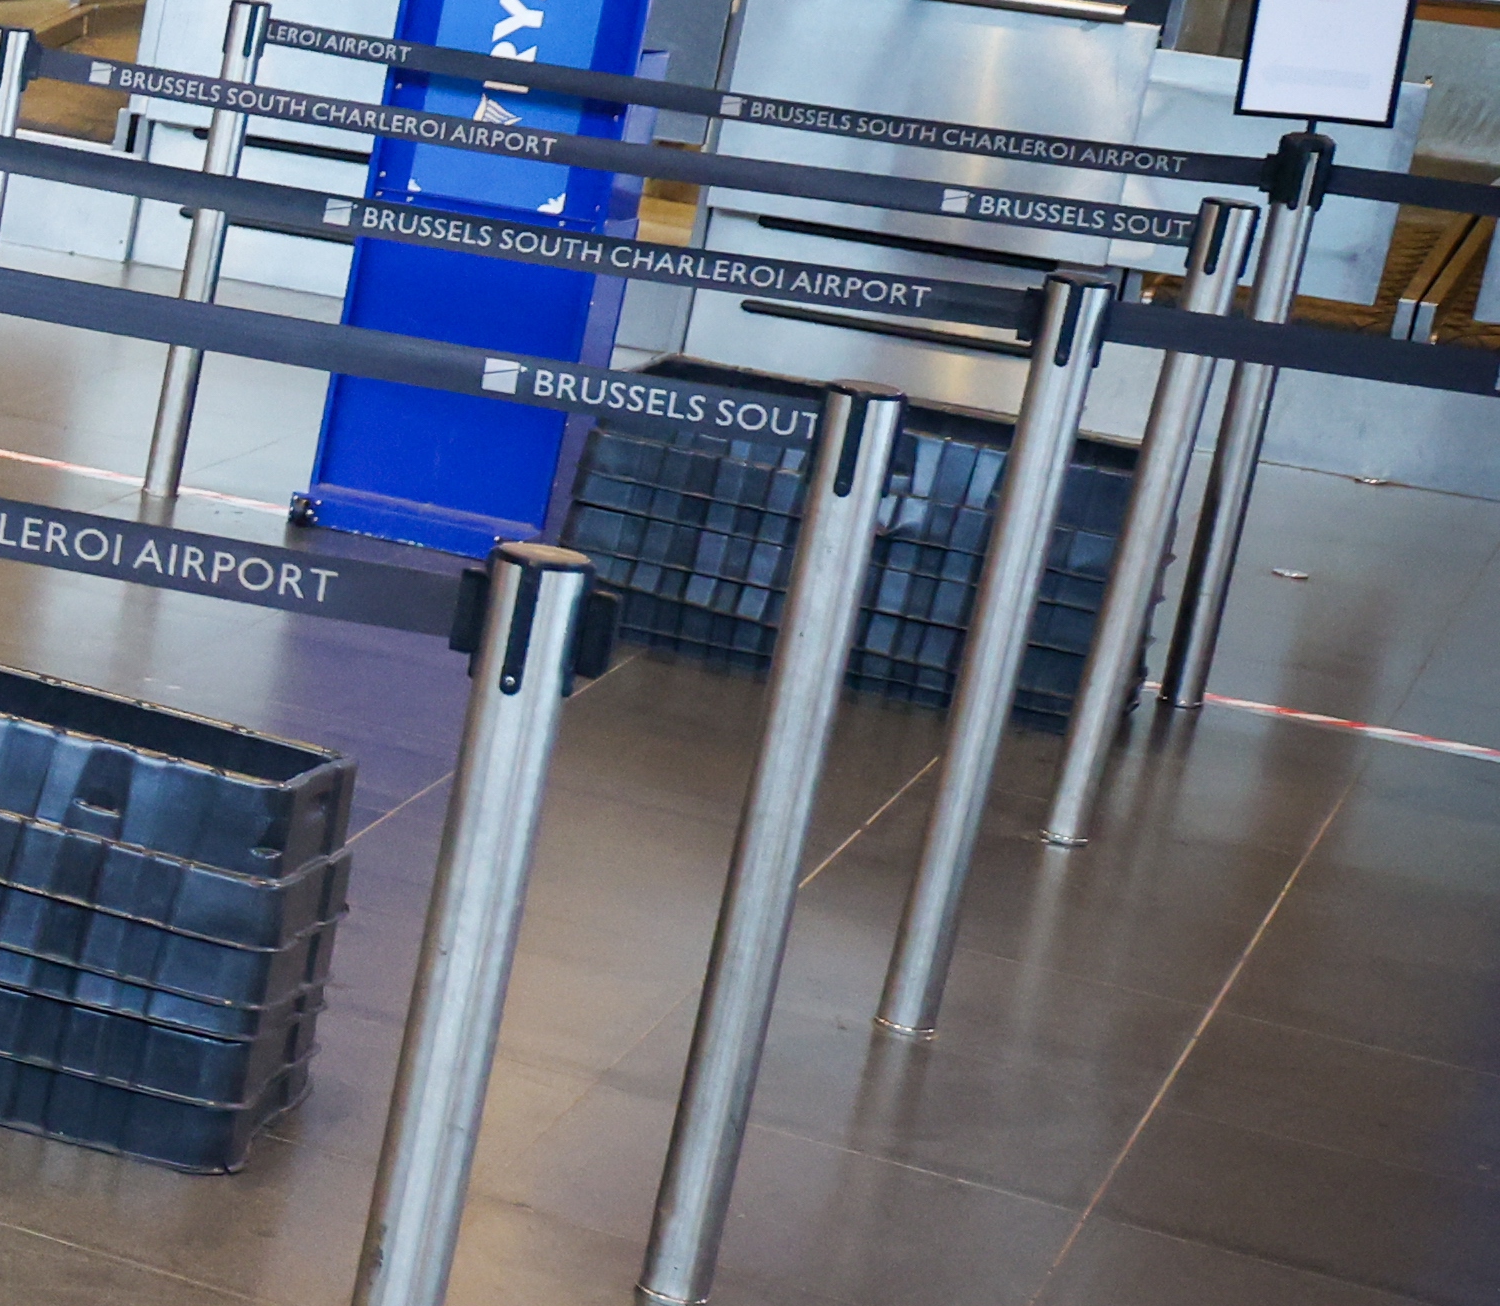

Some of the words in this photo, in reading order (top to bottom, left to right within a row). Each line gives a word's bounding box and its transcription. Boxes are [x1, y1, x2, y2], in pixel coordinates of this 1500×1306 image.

[120, 69, 220, 103] BRUSSELS
[225, 87, 306, 117] SOUTH
[312, 103, 446, 140] CHARLEROI
[451, 124, 557, 157] AIRPORT
[751, 101, 852, 133] BRUSSELS
[857, 118, 936, 143] SOUTH
[942, 127, 1075, 162] CHARLEROI
[1081, 147, 1187, 175] AIRPORT
[979, 195, 1105, 231] BRUSSELS
[1111, 211, 1192, 239] SOUT
[362, 205, 493, 248] BRUSSELS
[499, 229, 603, 265] SOUTH
[611, 246, 785, 291] CHARLEROI
[790, 271, 932, 310] AIRPORT
[534, 372, 705, 423] BRUSSELS
[715, 398, 818, 440] SOUT
[134, 538, 339, 604] AIRPORT
